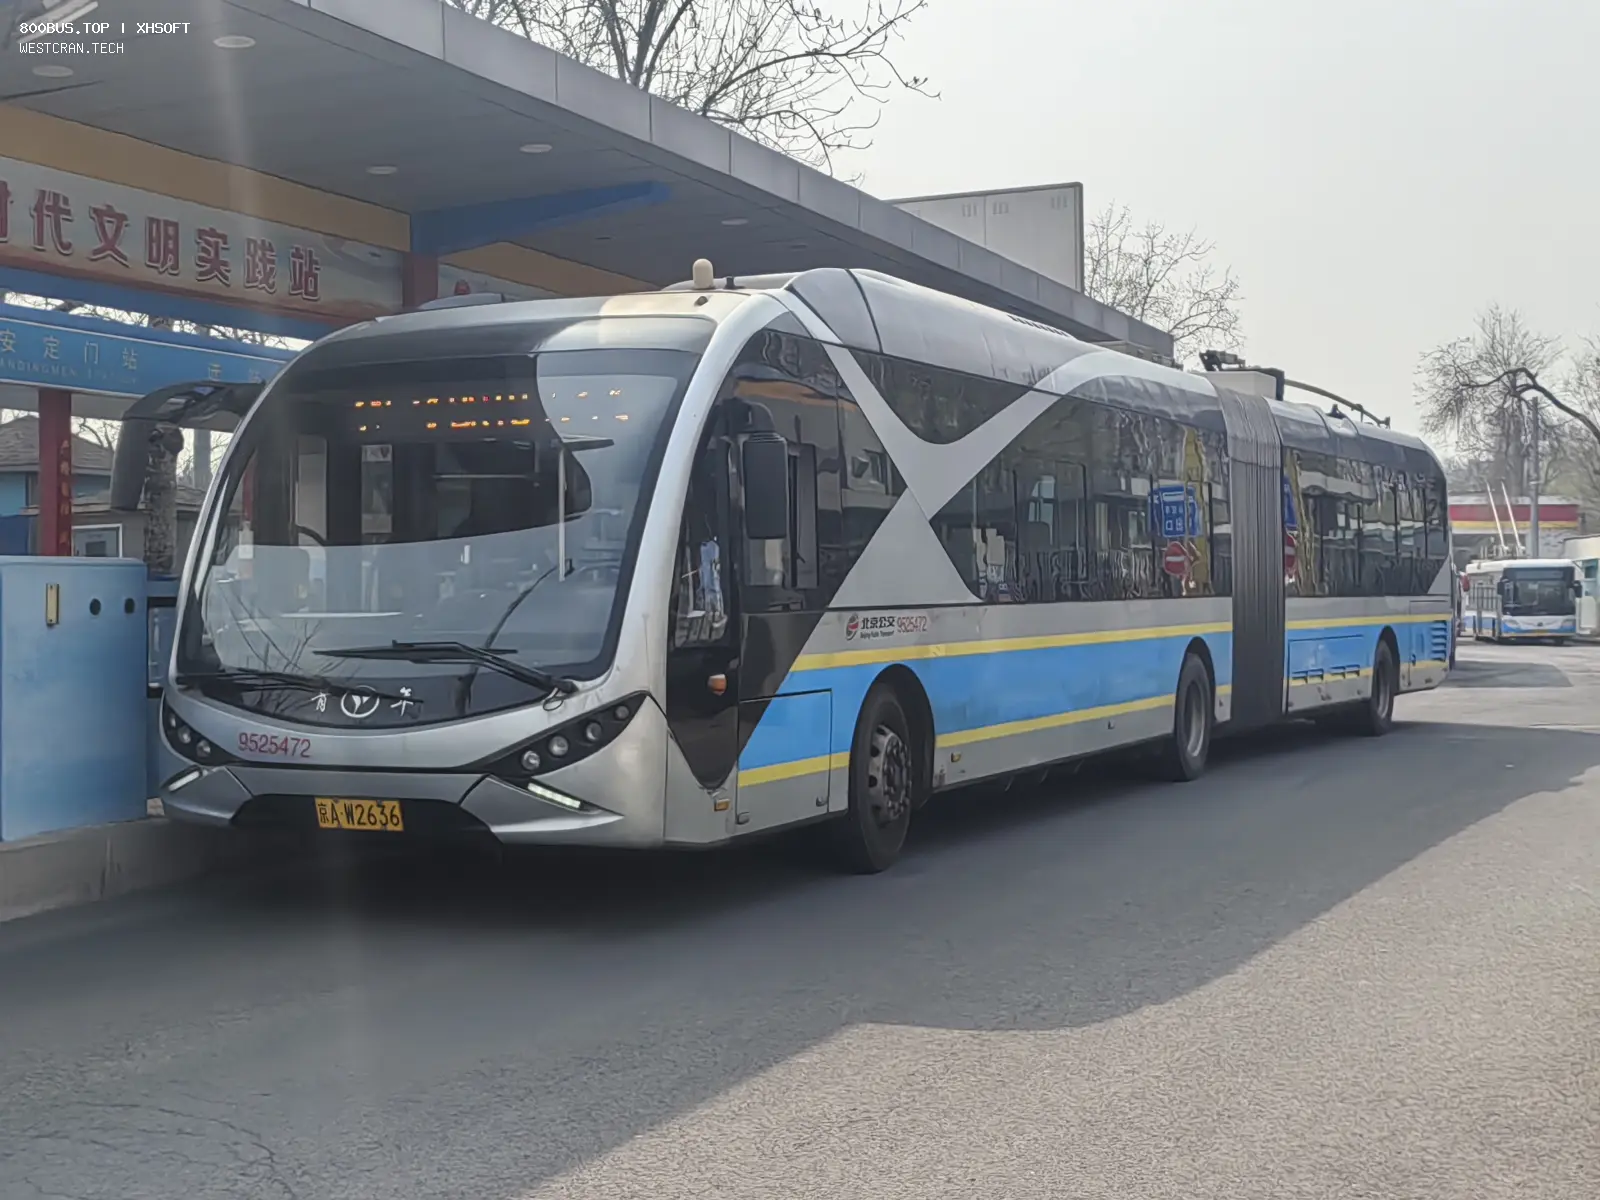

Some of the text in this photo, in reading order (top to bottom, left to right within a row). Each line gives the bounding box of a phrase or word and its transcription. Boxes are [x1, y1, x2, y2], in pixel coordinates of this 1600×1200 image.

[0, 328, 138, 370] 安定门站
[238, 732, 312, 758] 9525472
